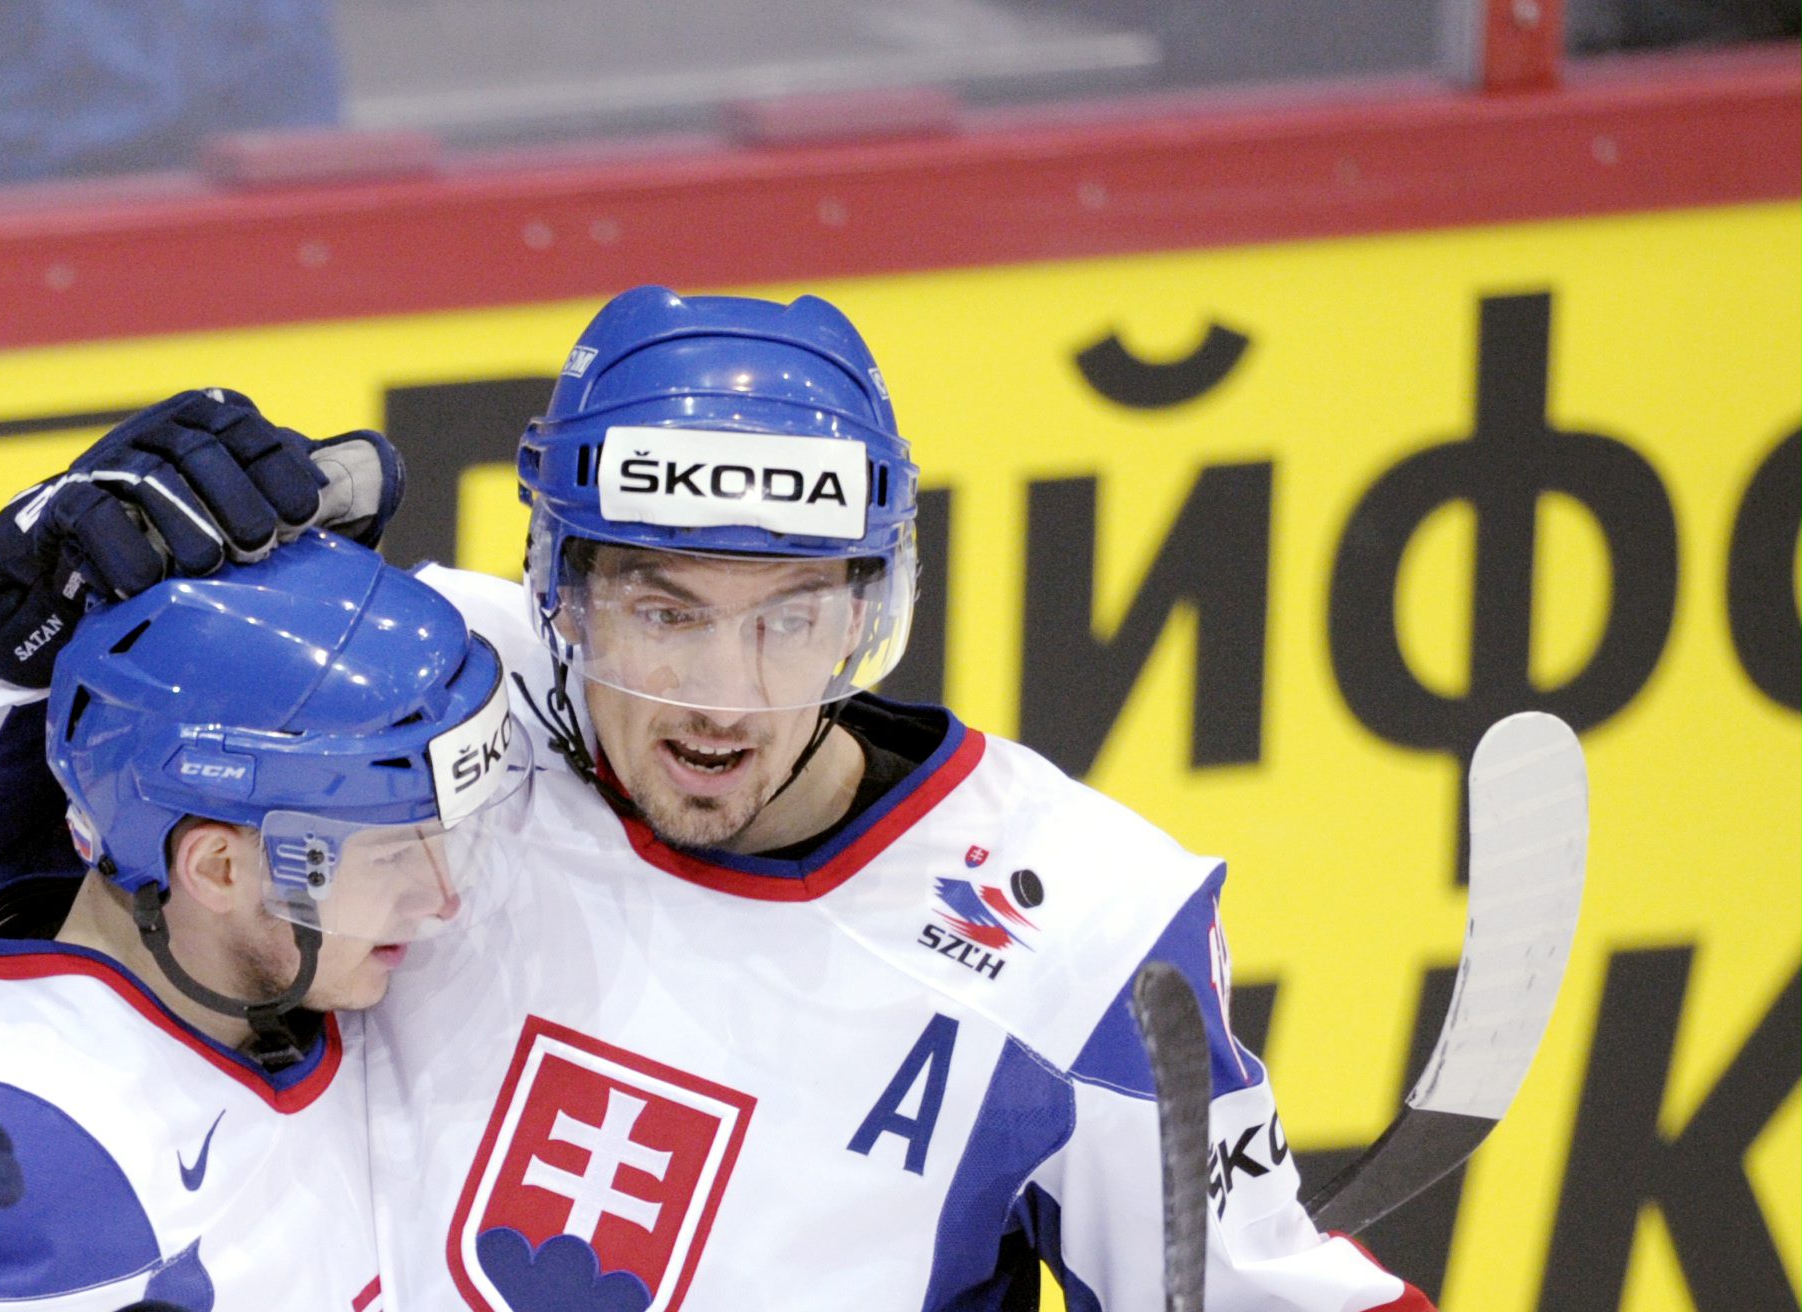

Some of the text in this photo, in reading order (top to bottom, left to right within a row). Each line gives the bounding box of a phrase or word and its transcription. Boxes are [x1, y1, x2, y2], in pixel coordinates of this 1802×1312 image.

[620, 451, 847, 506] ŠKODA
[14, 614, 64, 662] SATAN
[181, 763, 246, 779] CCM
[847, 1012, 960, 1177] A
